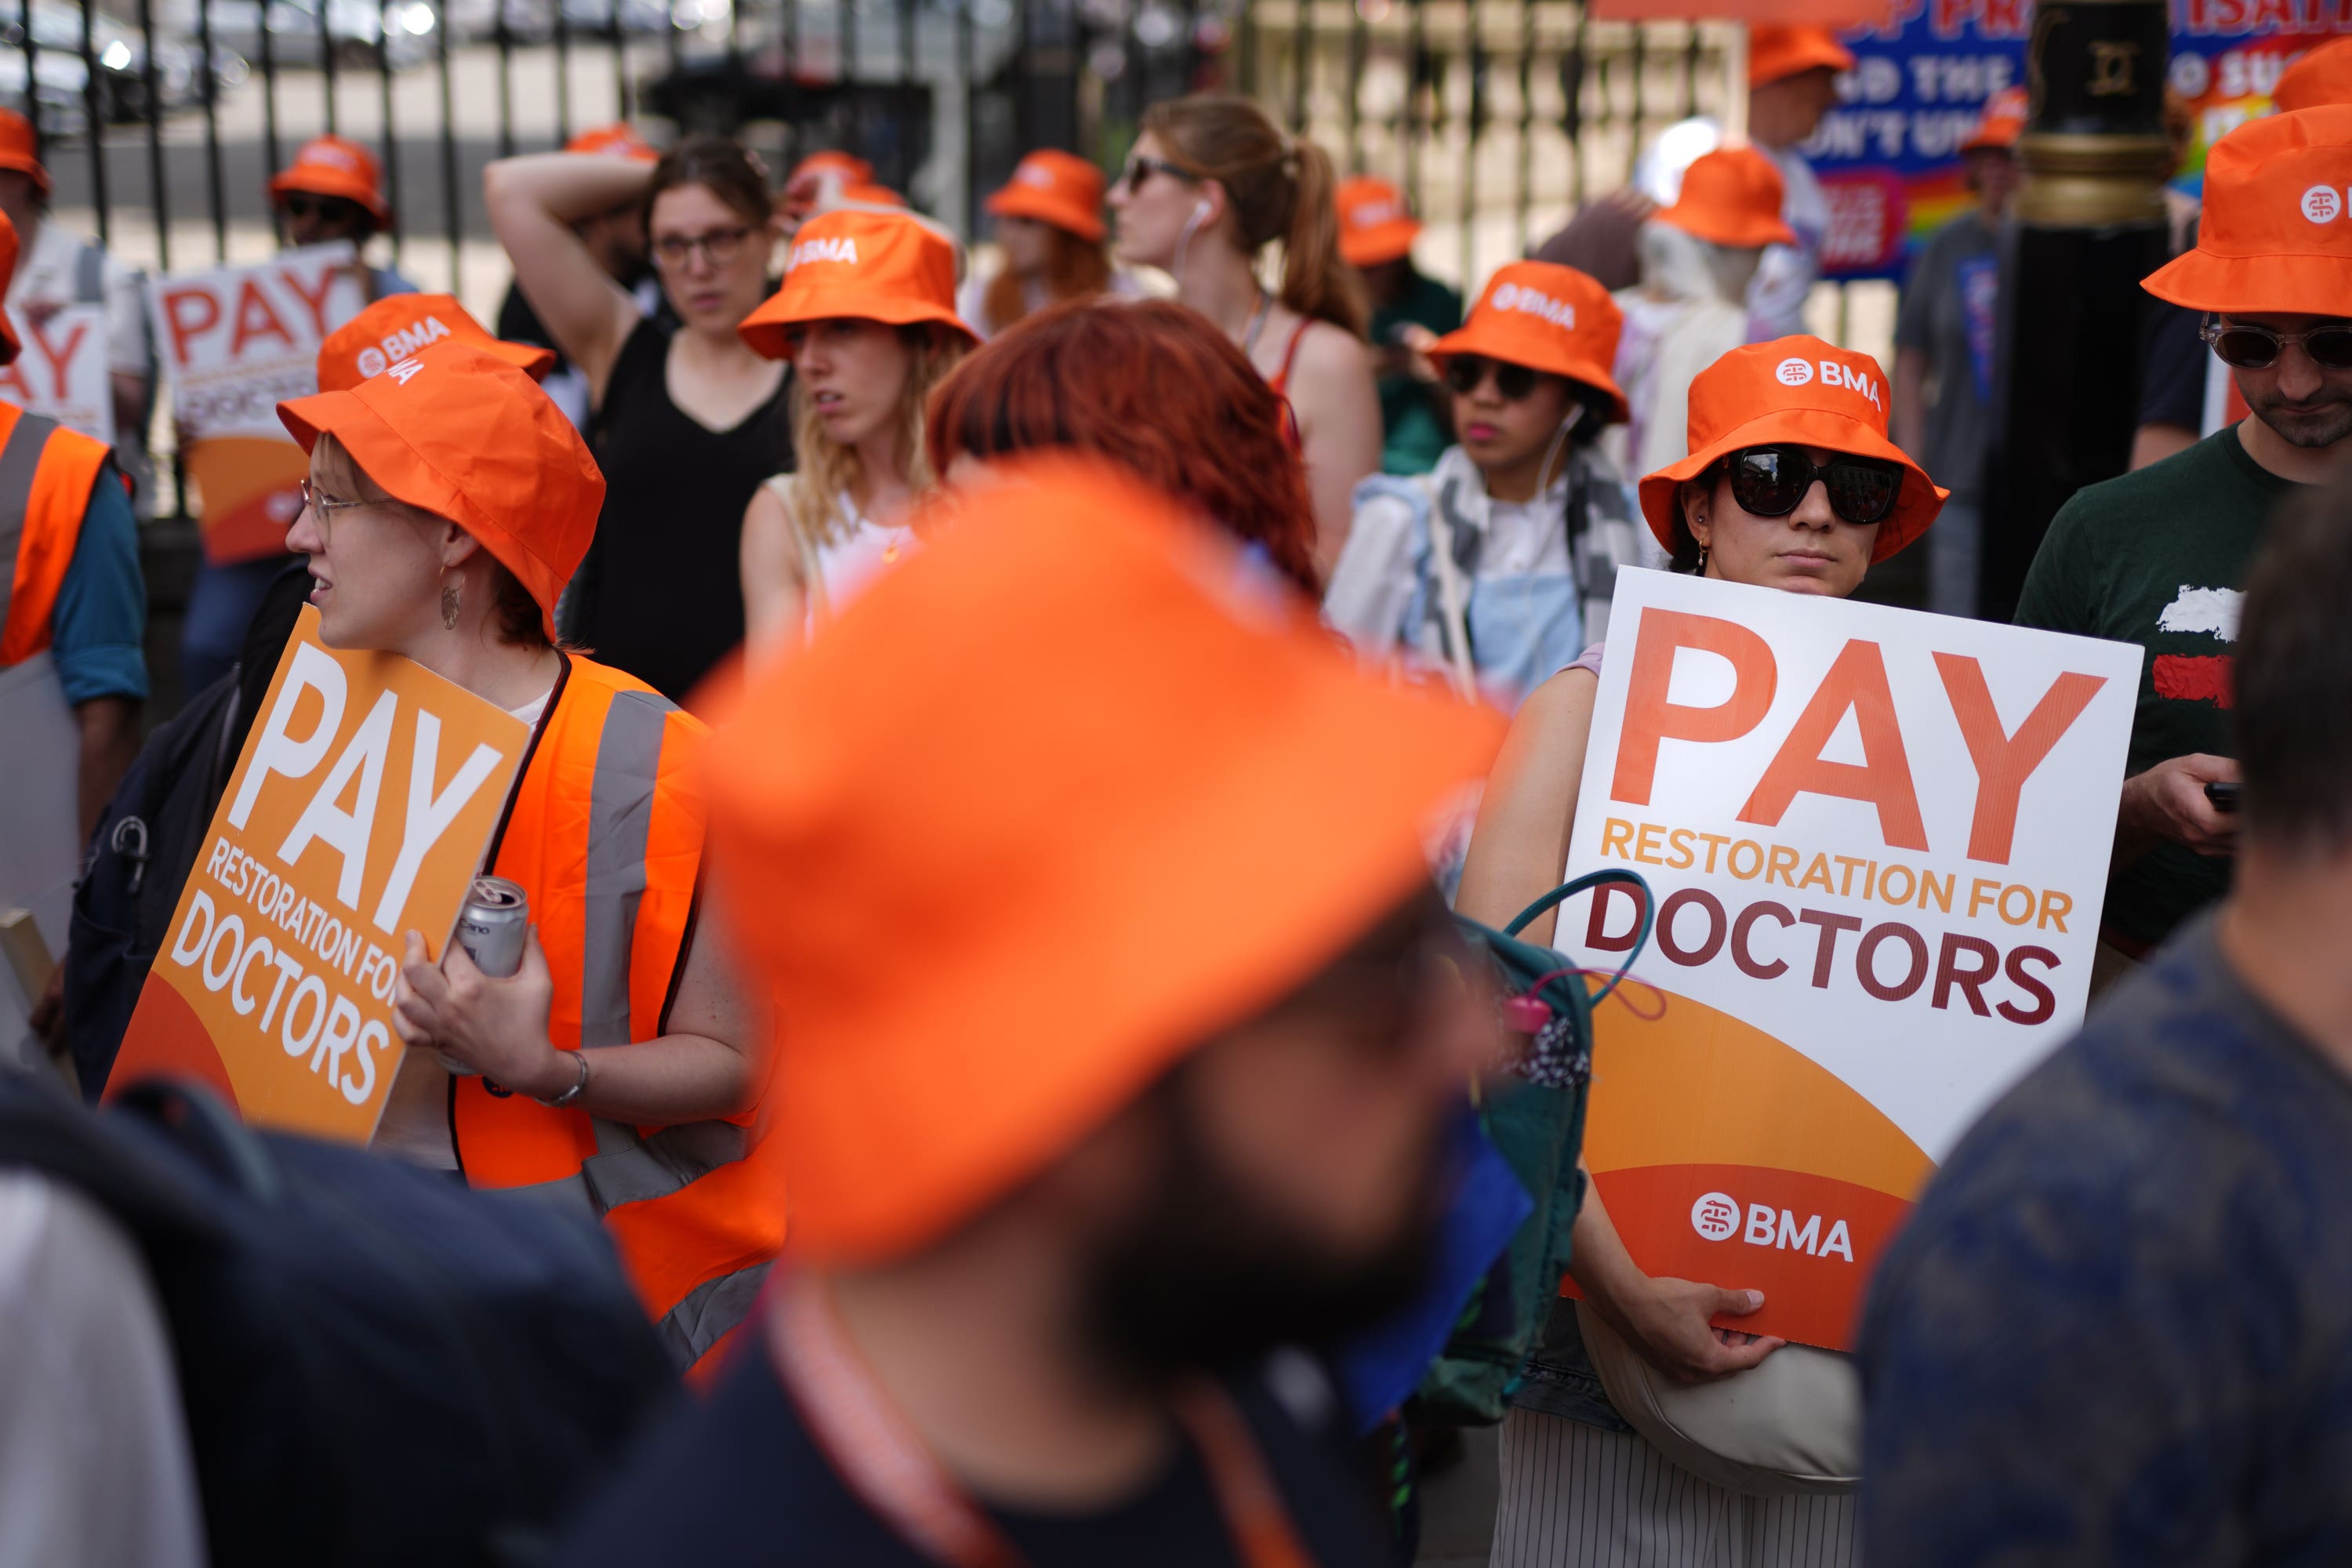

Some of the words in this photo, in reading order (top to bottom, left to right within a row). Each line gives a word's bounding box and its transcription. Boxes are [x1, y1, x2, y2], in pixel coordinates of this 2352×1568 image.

[162, 263, 336, 366] PAY
[381, 316, 451, 362] BMA
[1819, 361, 1882, 412] BMA
[227, 641, 503, 936] PAY
[1610, 606, 2109, 866] PAY
[206, 837, 363, 977] RESTORATION
[355, 943, 397, 1008] FO
[1600, 817, 1956, 914] RESTORATION
[1968, 877, 2074, 934] FOR
[171, 888, 390, 1106] DOCTORS
[1584, 881, 2062, 1025] DOCTORS
[1744, 1203, 1854, 1263] BMA
